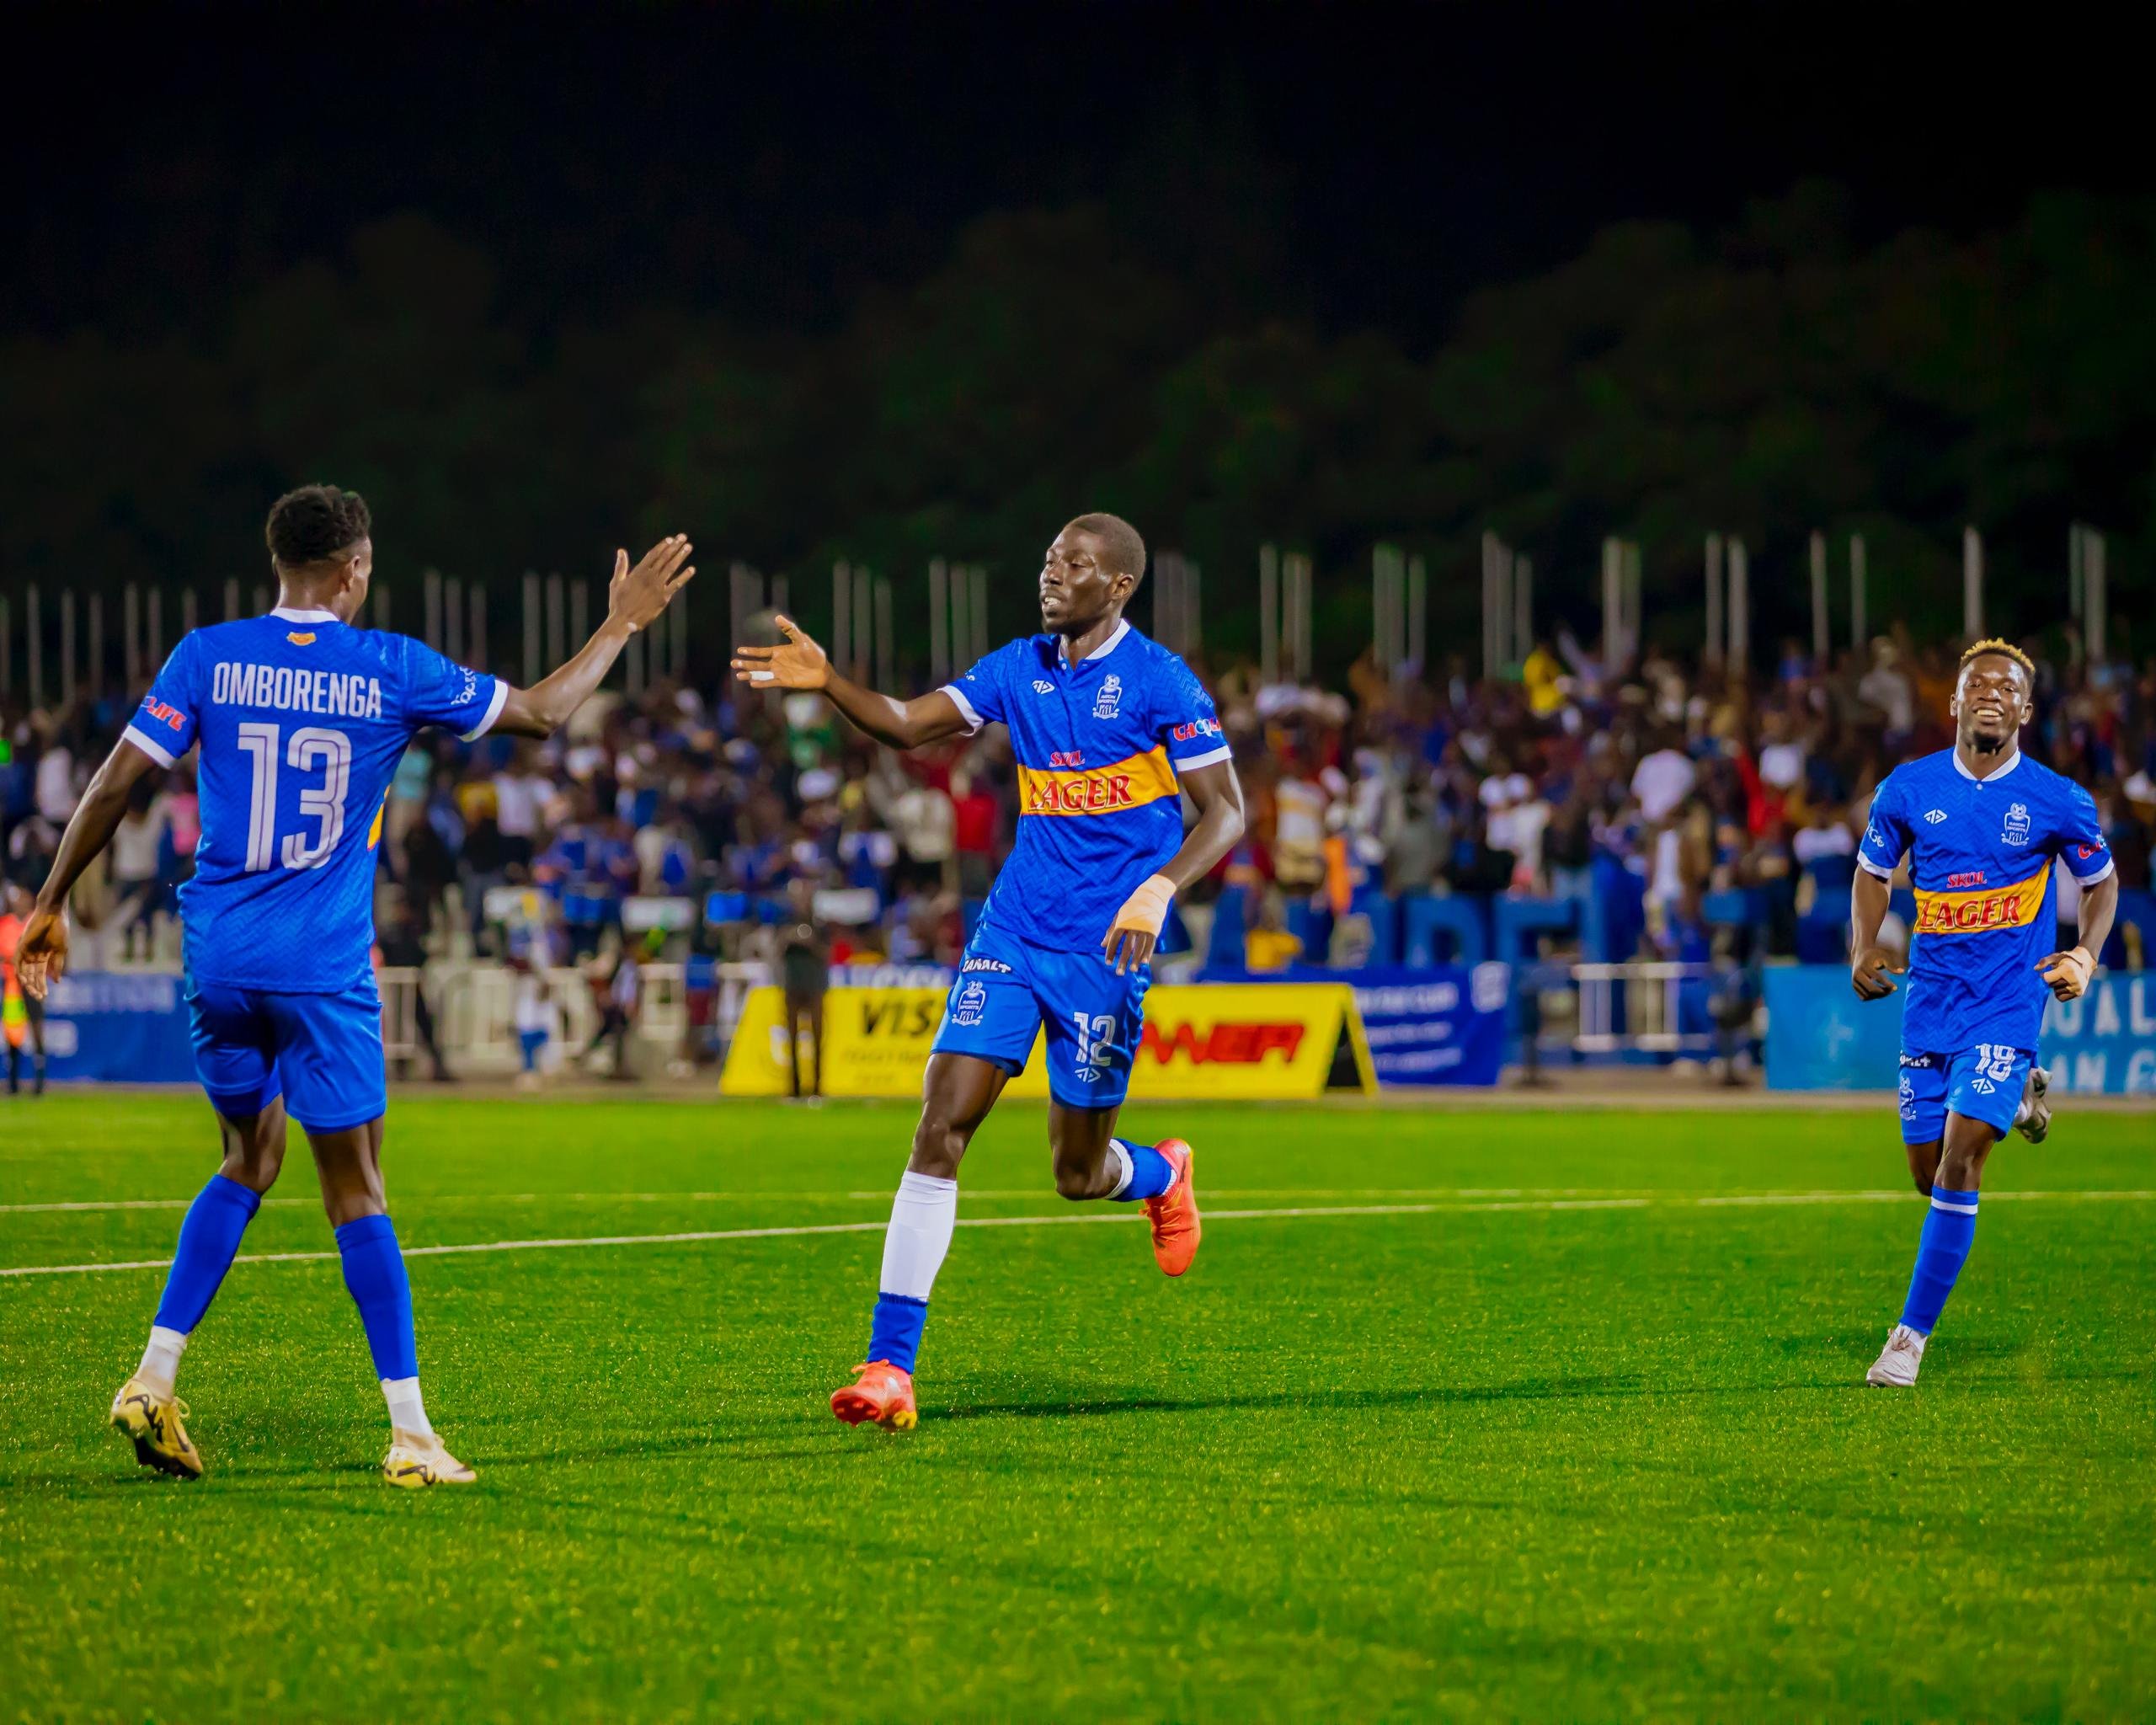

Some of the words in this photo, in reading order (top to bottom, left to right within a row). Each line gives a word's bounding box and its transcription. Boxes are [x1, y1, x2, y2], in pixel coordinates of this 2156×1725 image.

[212, 661, 382, 719] OMBORENGA
[237, 722, 352, 873] 13
[1027, 773, 1134, 811] LAGER
[1946, 870, 1987, 889] SKOL
[1920, 895, 2020, 930] LAGER
[1074, 1012, 1116, 1067] 12
[1975, 1043, 2015, 1082] 18
